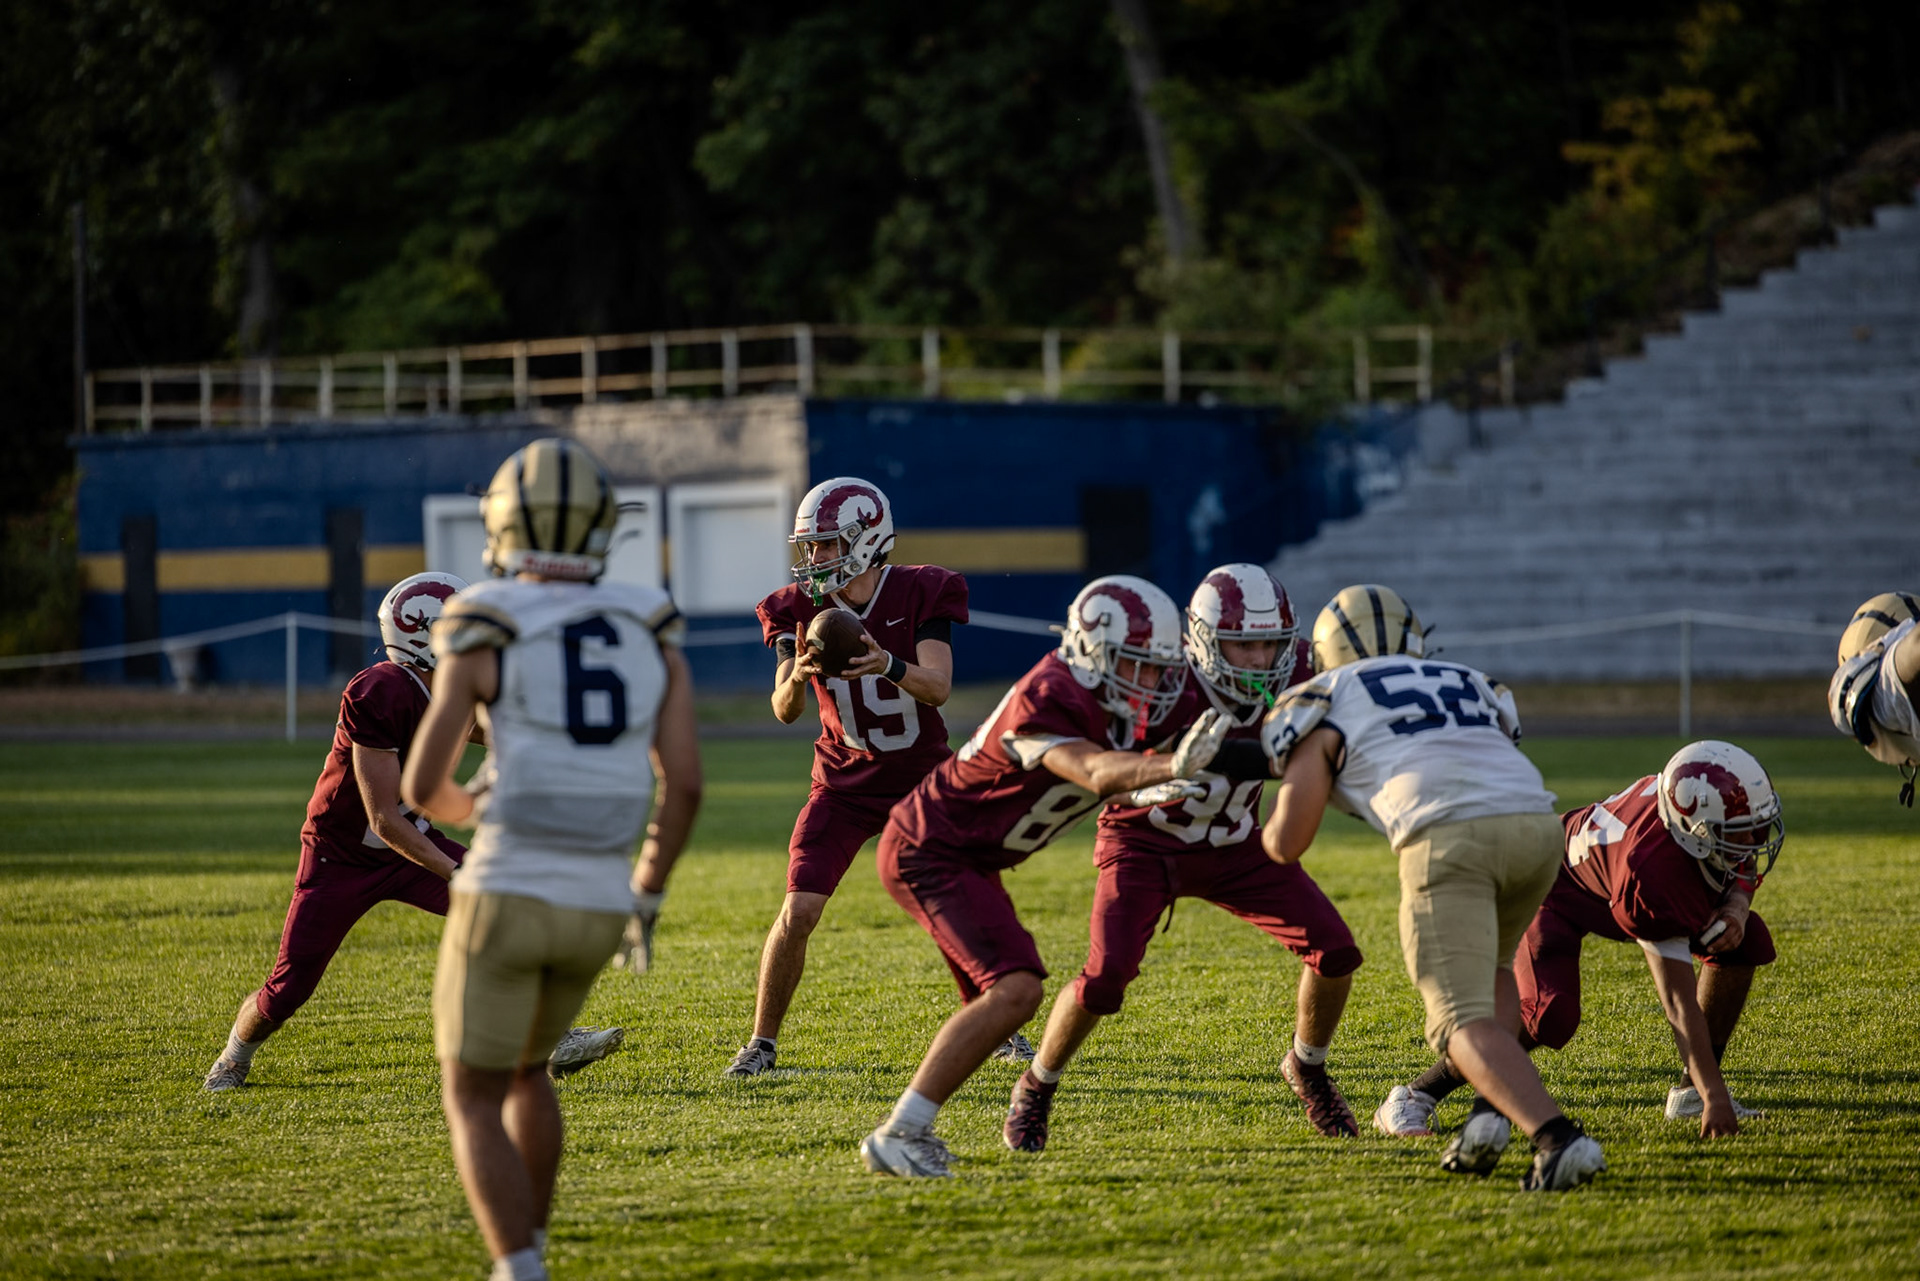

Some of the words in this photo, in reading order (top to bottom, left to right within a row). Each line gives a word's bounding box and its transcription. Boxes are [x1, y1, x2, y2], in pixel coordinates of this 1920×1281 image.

[564, 615, 627, 745] 6
[826, 673, 920, 752] 19
[1357, 664, 1491, 735] 52
